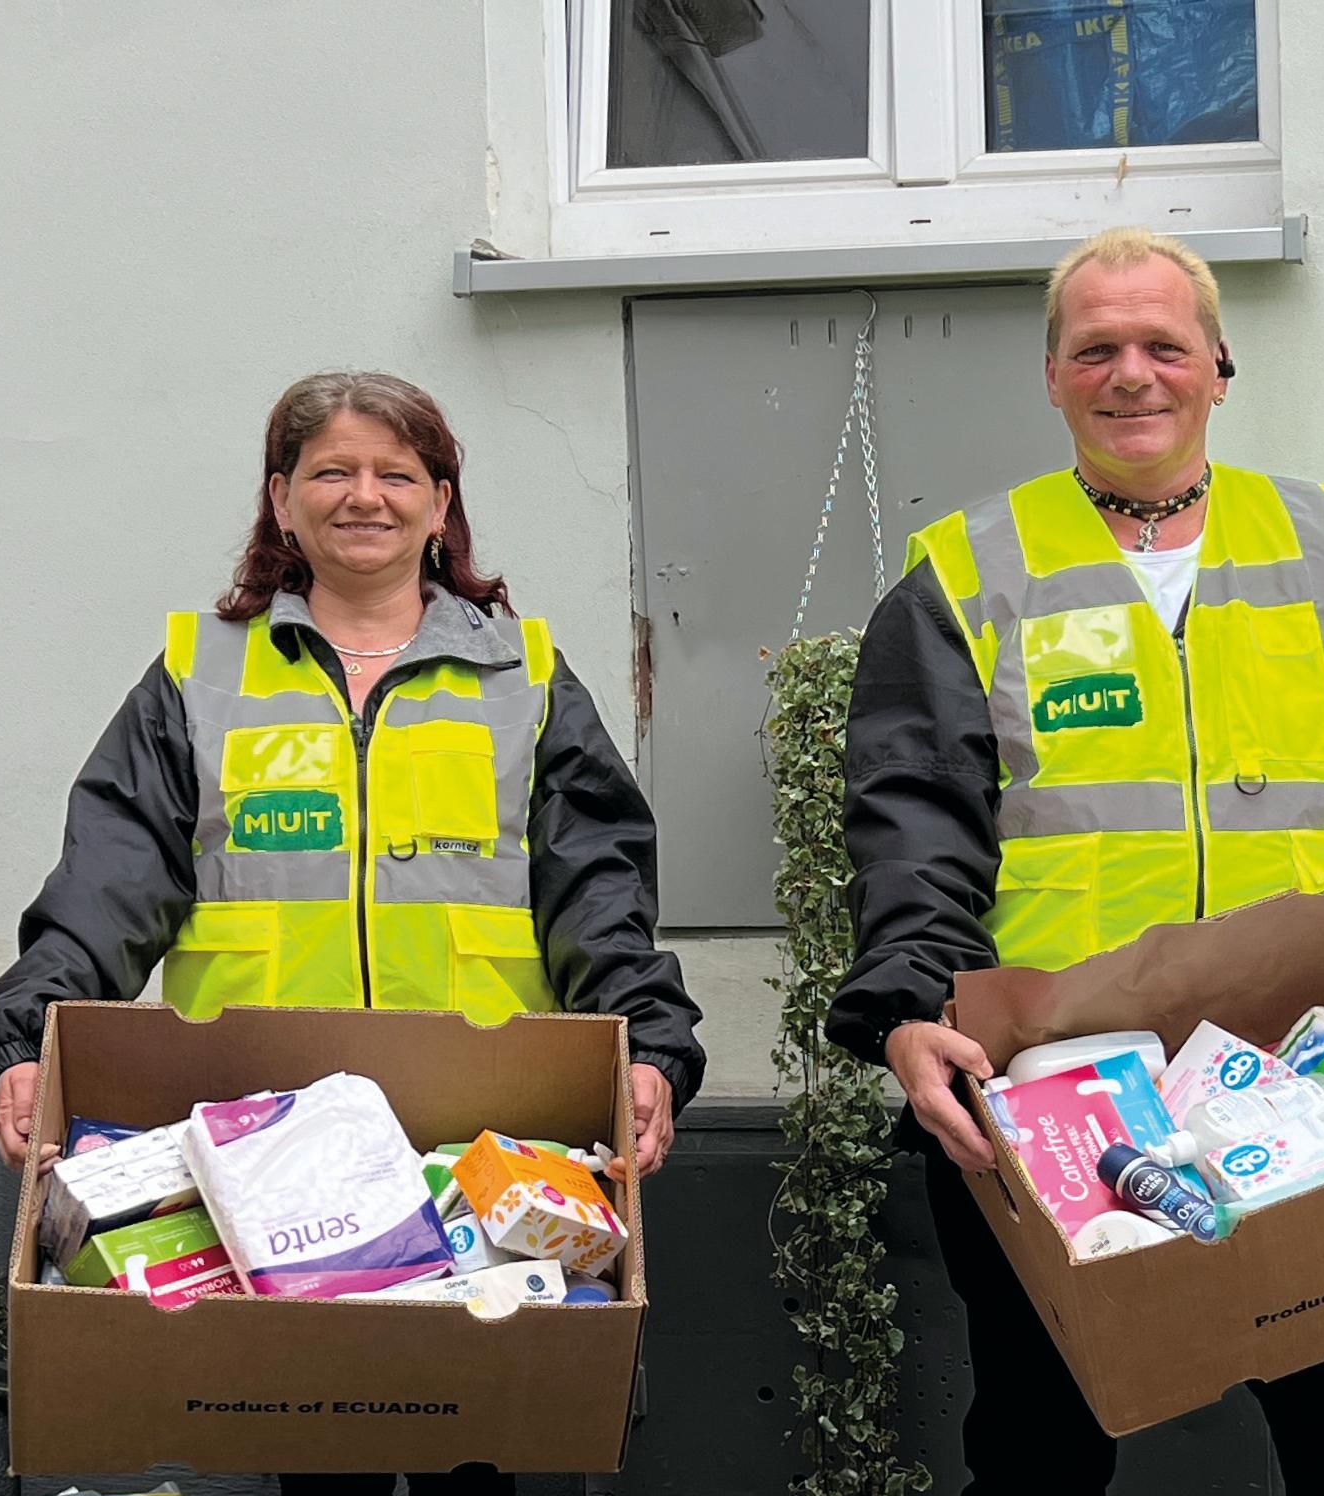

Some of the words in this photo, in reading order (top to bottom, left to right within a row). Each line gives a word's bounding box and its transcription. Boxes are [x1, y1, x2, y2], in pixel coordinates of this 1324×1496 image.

[1038, 1114, 1089, 1202] Carefree
[1076, 1148, 1099, 1184] COTTON
[1135, 1170, 1163, 1198] NIVEA
[1176, 1199, 1201, 1221] 0%
[268, 1212, 362, 1257] senta
[181, 1275, 233, 1300] NORMAL
[187, 1401, 281, 1416] Product
[298, 1401, 326, 1415] of
[332, 1402, 459, 1416] ECUADOR
